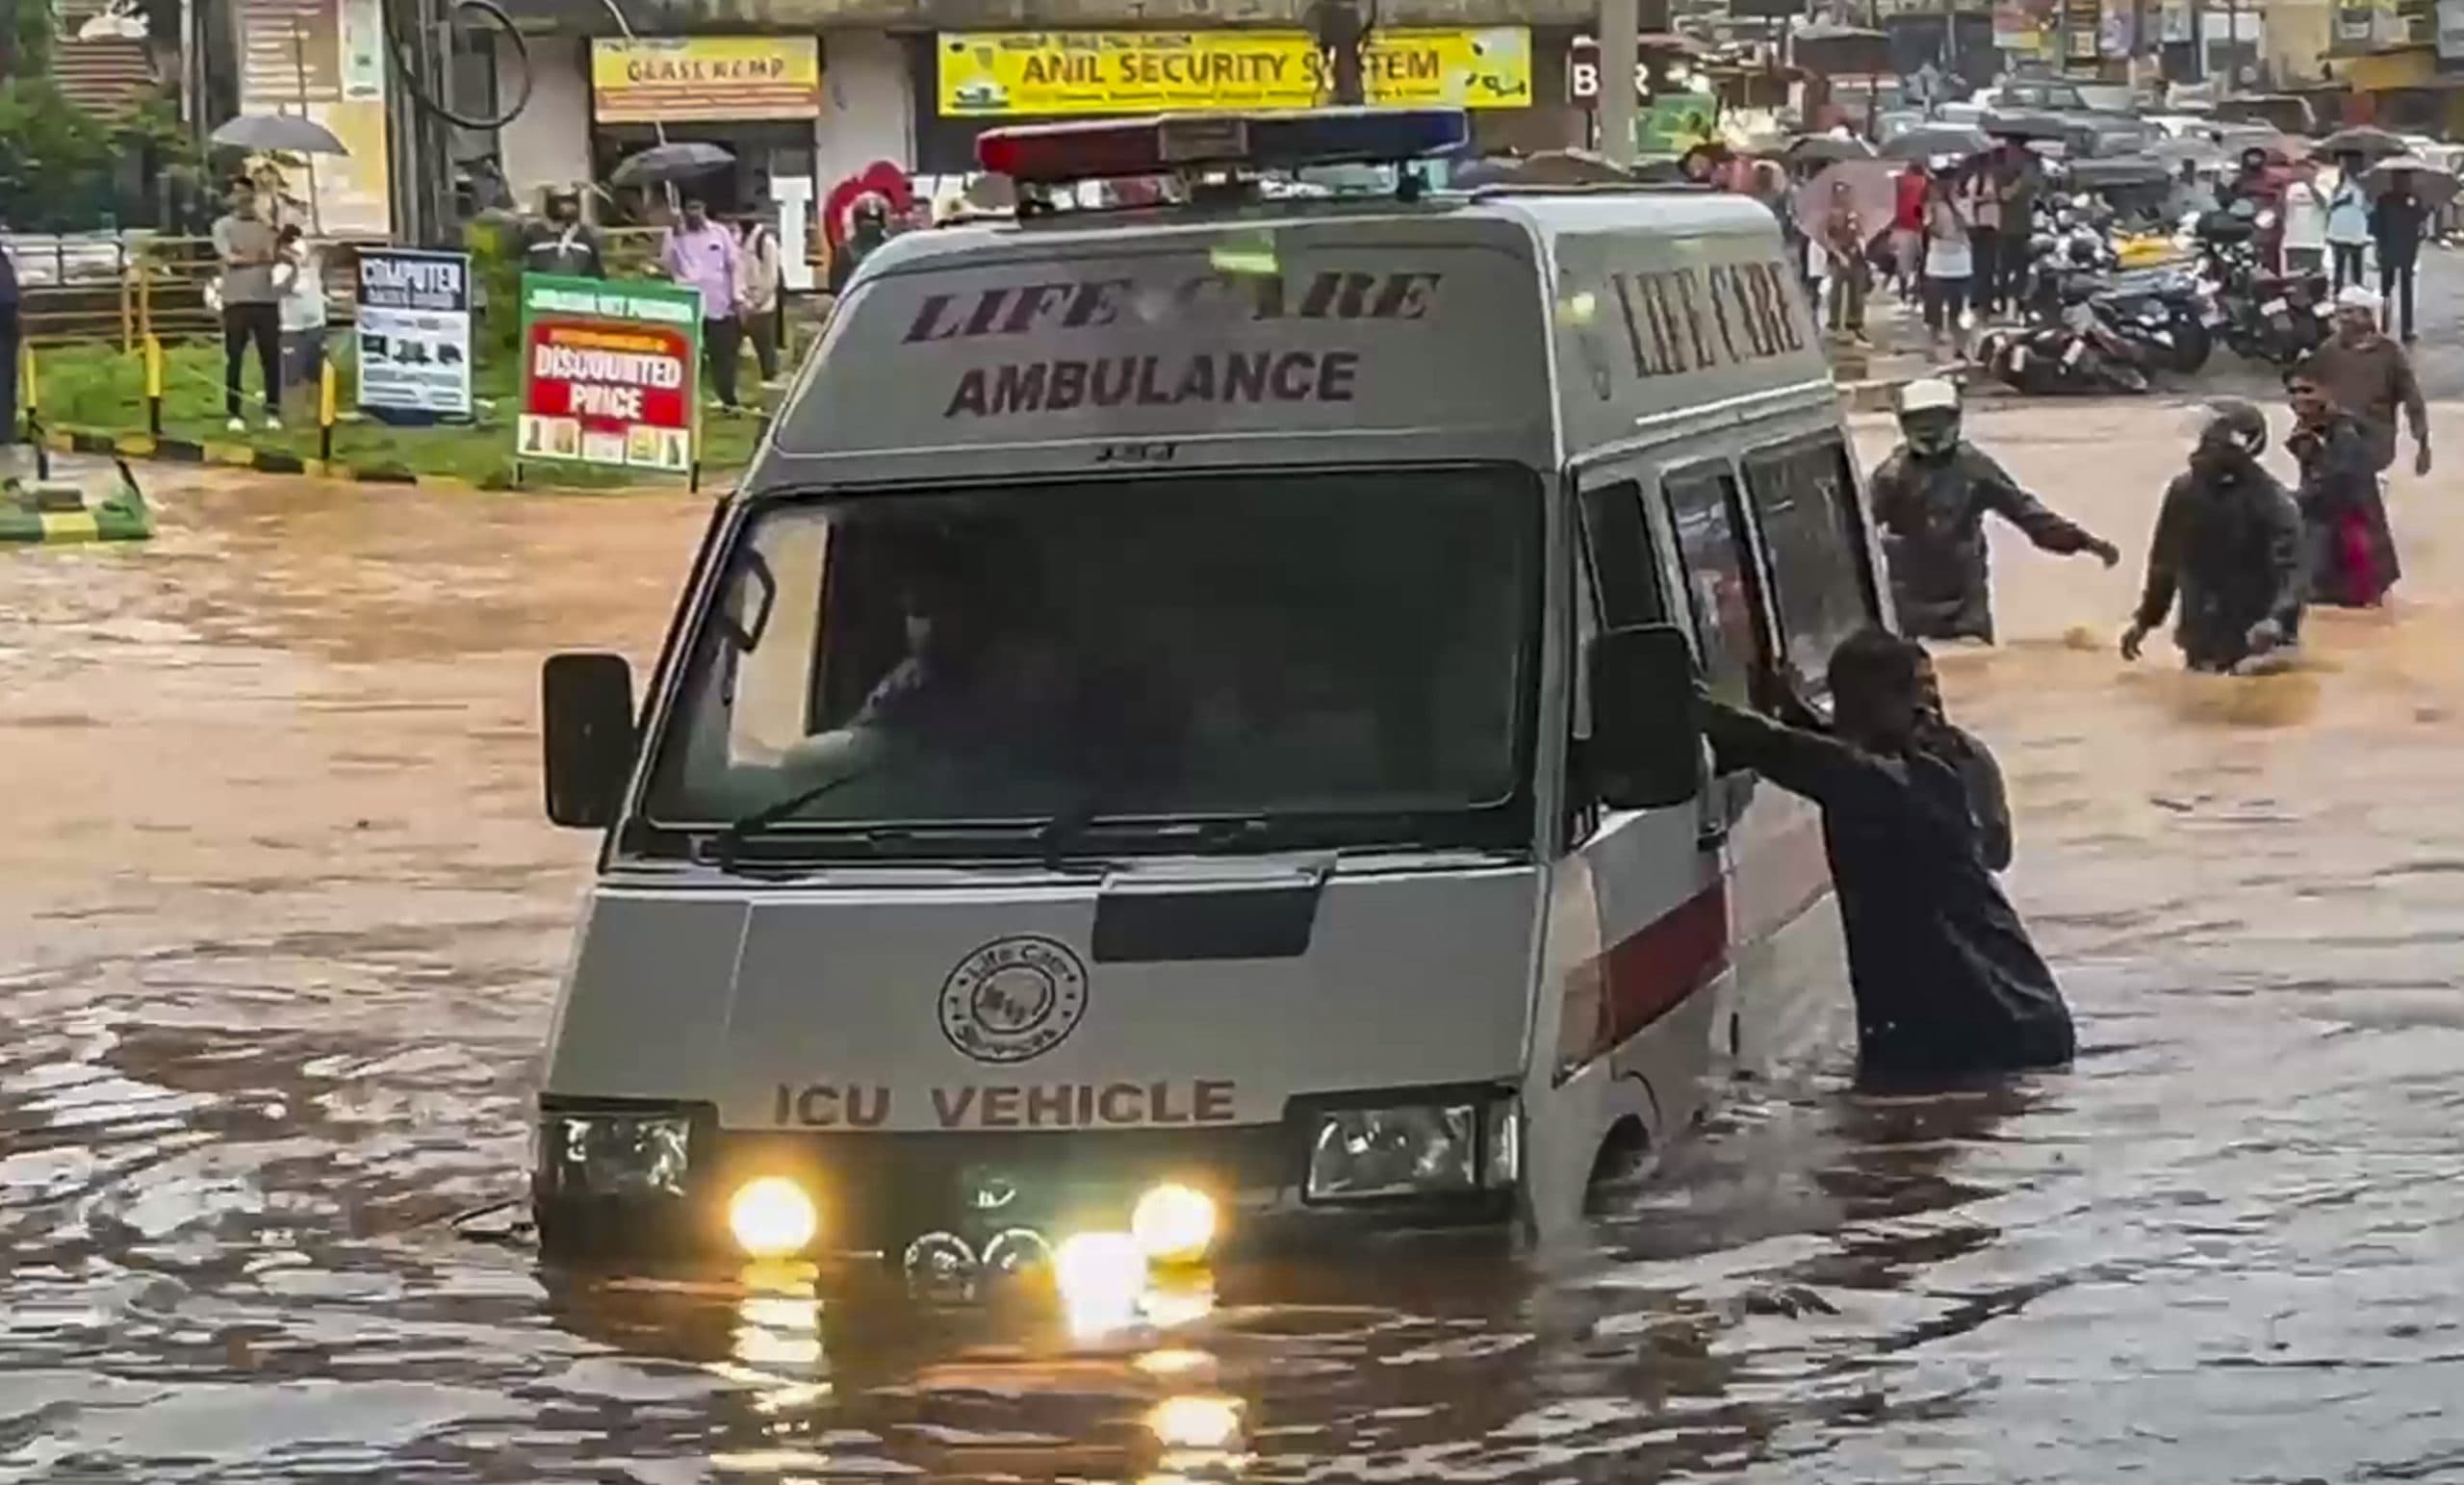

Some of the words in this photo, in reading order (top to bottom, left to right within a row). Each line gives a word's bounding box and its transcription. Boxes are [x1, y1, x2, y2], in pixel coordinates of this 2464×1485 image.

[1022, 55, 1106, 84] ANIL
[1119, 51, 1288, 84] SECURITY
[1301, 50, 1439, 83] STEM
[1573, 63, 1651, 95] BR
[901, 277, 1132, 345] LIFE
[1177, 271, 1441, 322] CARE
[1612, 267, 1716, 378] LIFE
[1707, 261, 1804, 364] CARE
[534, 344, 682, 389] DISCOUNTED
[943, 351, 1359, 418] AMBULANCE
[569, 382, 646, 421] PRICE
[775, 1086, 891, 1127] ICU
[931, 1080, 1237, 1128] VEHICLE
